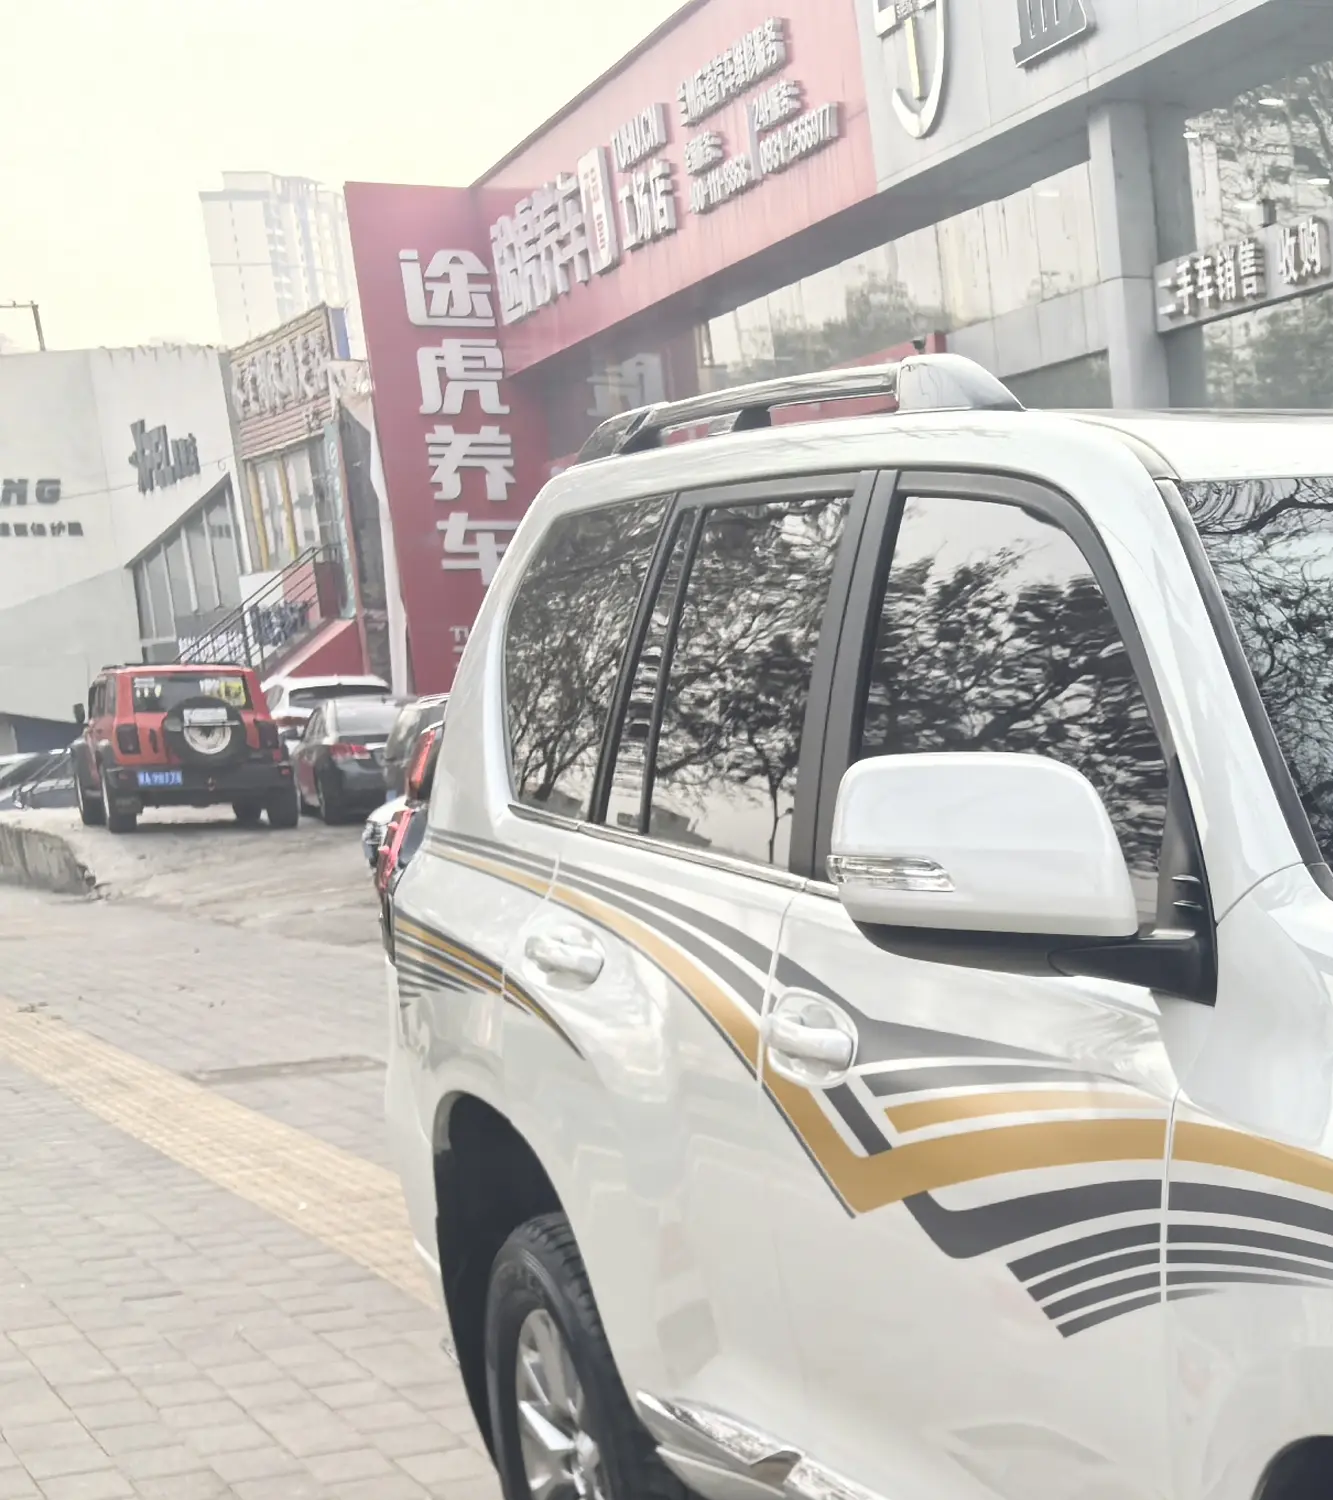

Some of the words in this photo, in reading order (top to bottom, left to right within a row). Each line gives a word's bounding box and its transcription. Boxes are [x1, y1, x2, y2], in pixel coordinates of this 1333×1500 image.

[618, 158, 677, 251] 工场店
[1157, 237, 1262, 315] 二手车销售
[1279, 215, 1322, 284] 收购
[399, 248, 521, 588] 途虎养车
